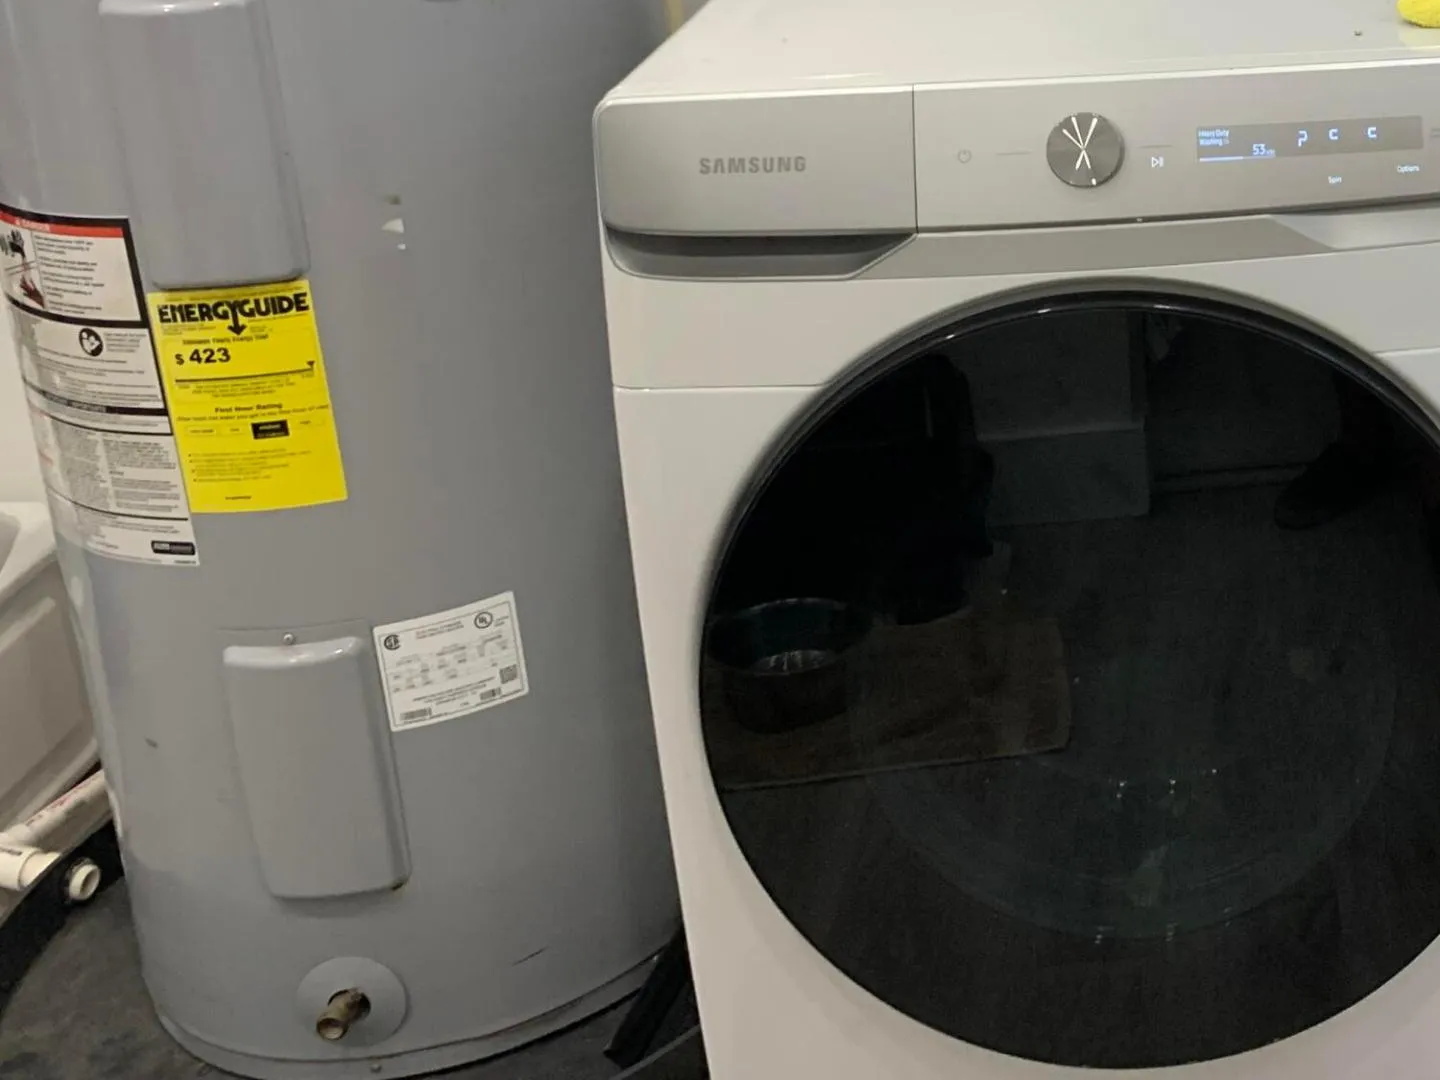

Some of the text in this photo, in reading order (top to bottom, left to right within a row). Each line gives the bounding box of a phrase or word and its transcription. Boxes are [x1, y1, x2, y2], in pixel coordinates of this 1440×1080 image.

[1252, 143, 1266, 155] 53
[699, 156, 806, 175] SAMSUNG
[189, 347, 230, 364] 423
